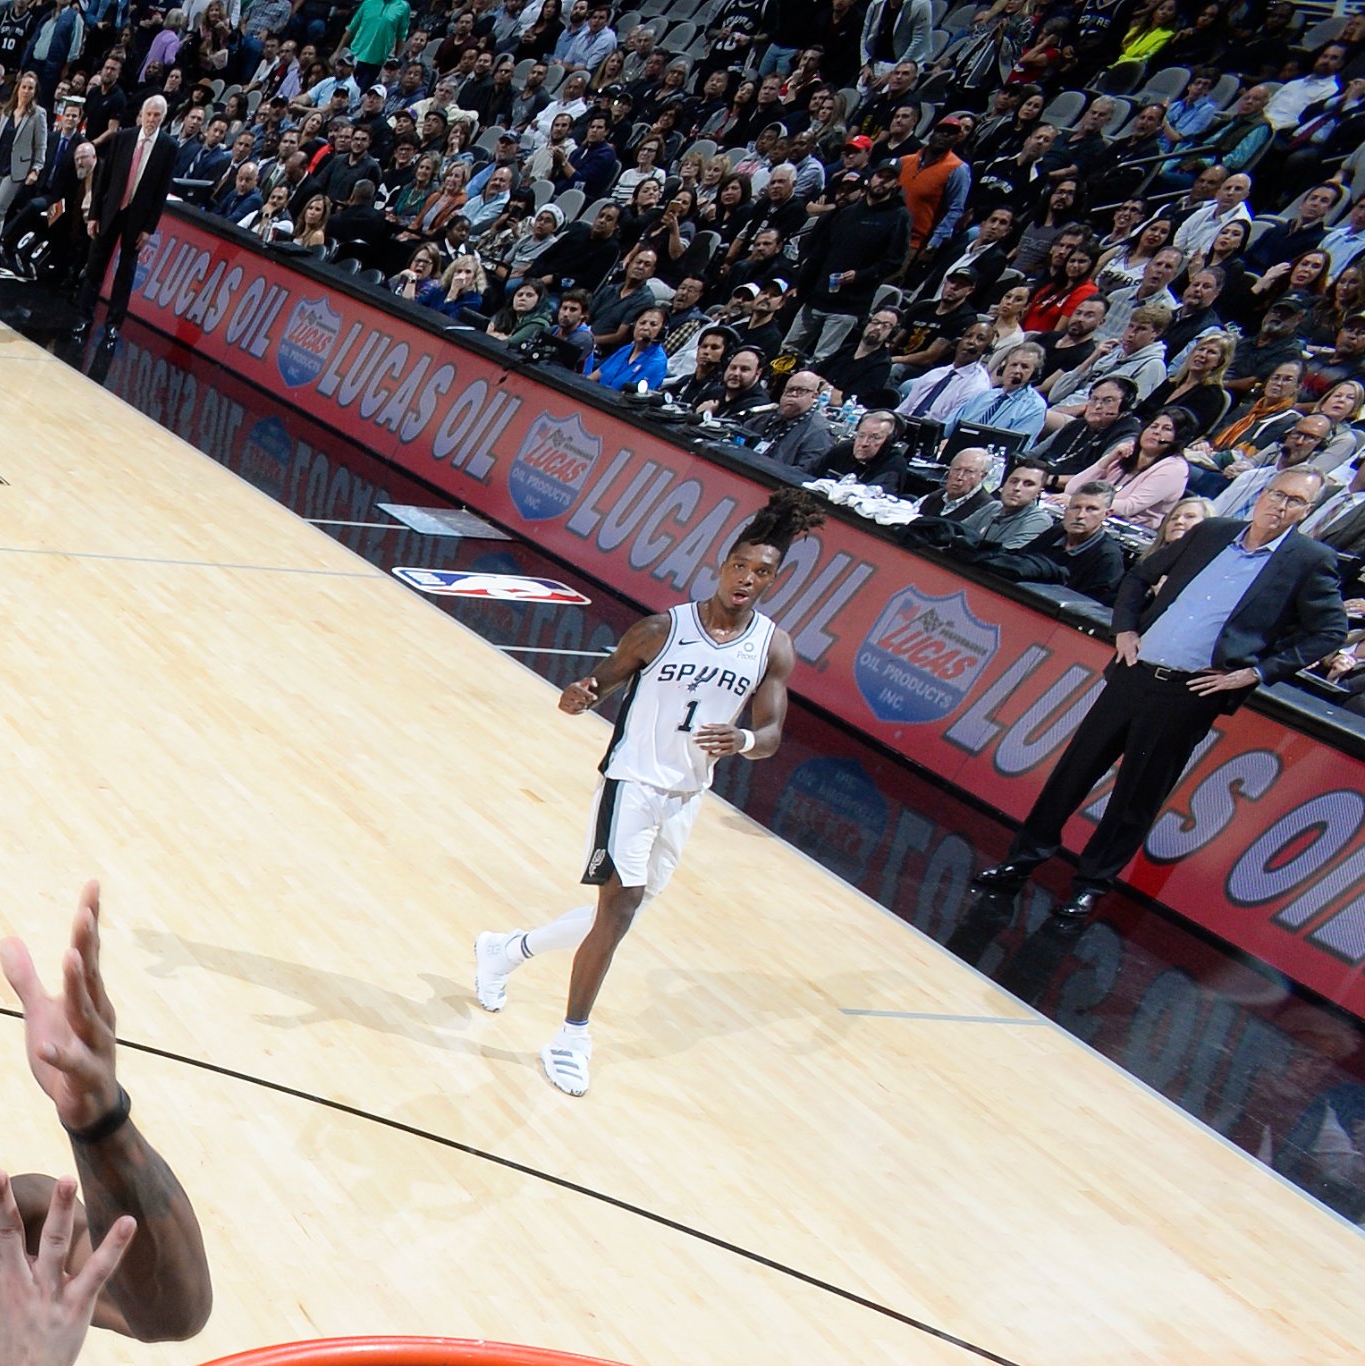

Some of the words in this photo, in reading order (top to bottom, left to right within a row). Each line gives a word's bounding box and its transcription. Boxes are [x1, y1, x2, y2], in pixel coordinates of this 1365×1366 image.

[2, 38, 16, 50] 10
[143, 237, 244, 334] LUCAS
[226, 275, 289, 360] OIL
[317, 322, 458, 445] LUCAS
[432, 379, 522, 481] OIL
[523, 442, 588, 483] LUCAS
[877, 622, 979, 680] LUCAS
[658, 664, 750, 696] SPURS
[860, 652, 880, 672] OIL
[883, 664, 953, 708] PRODUCTS
[677, 700, 698, 732] 1
